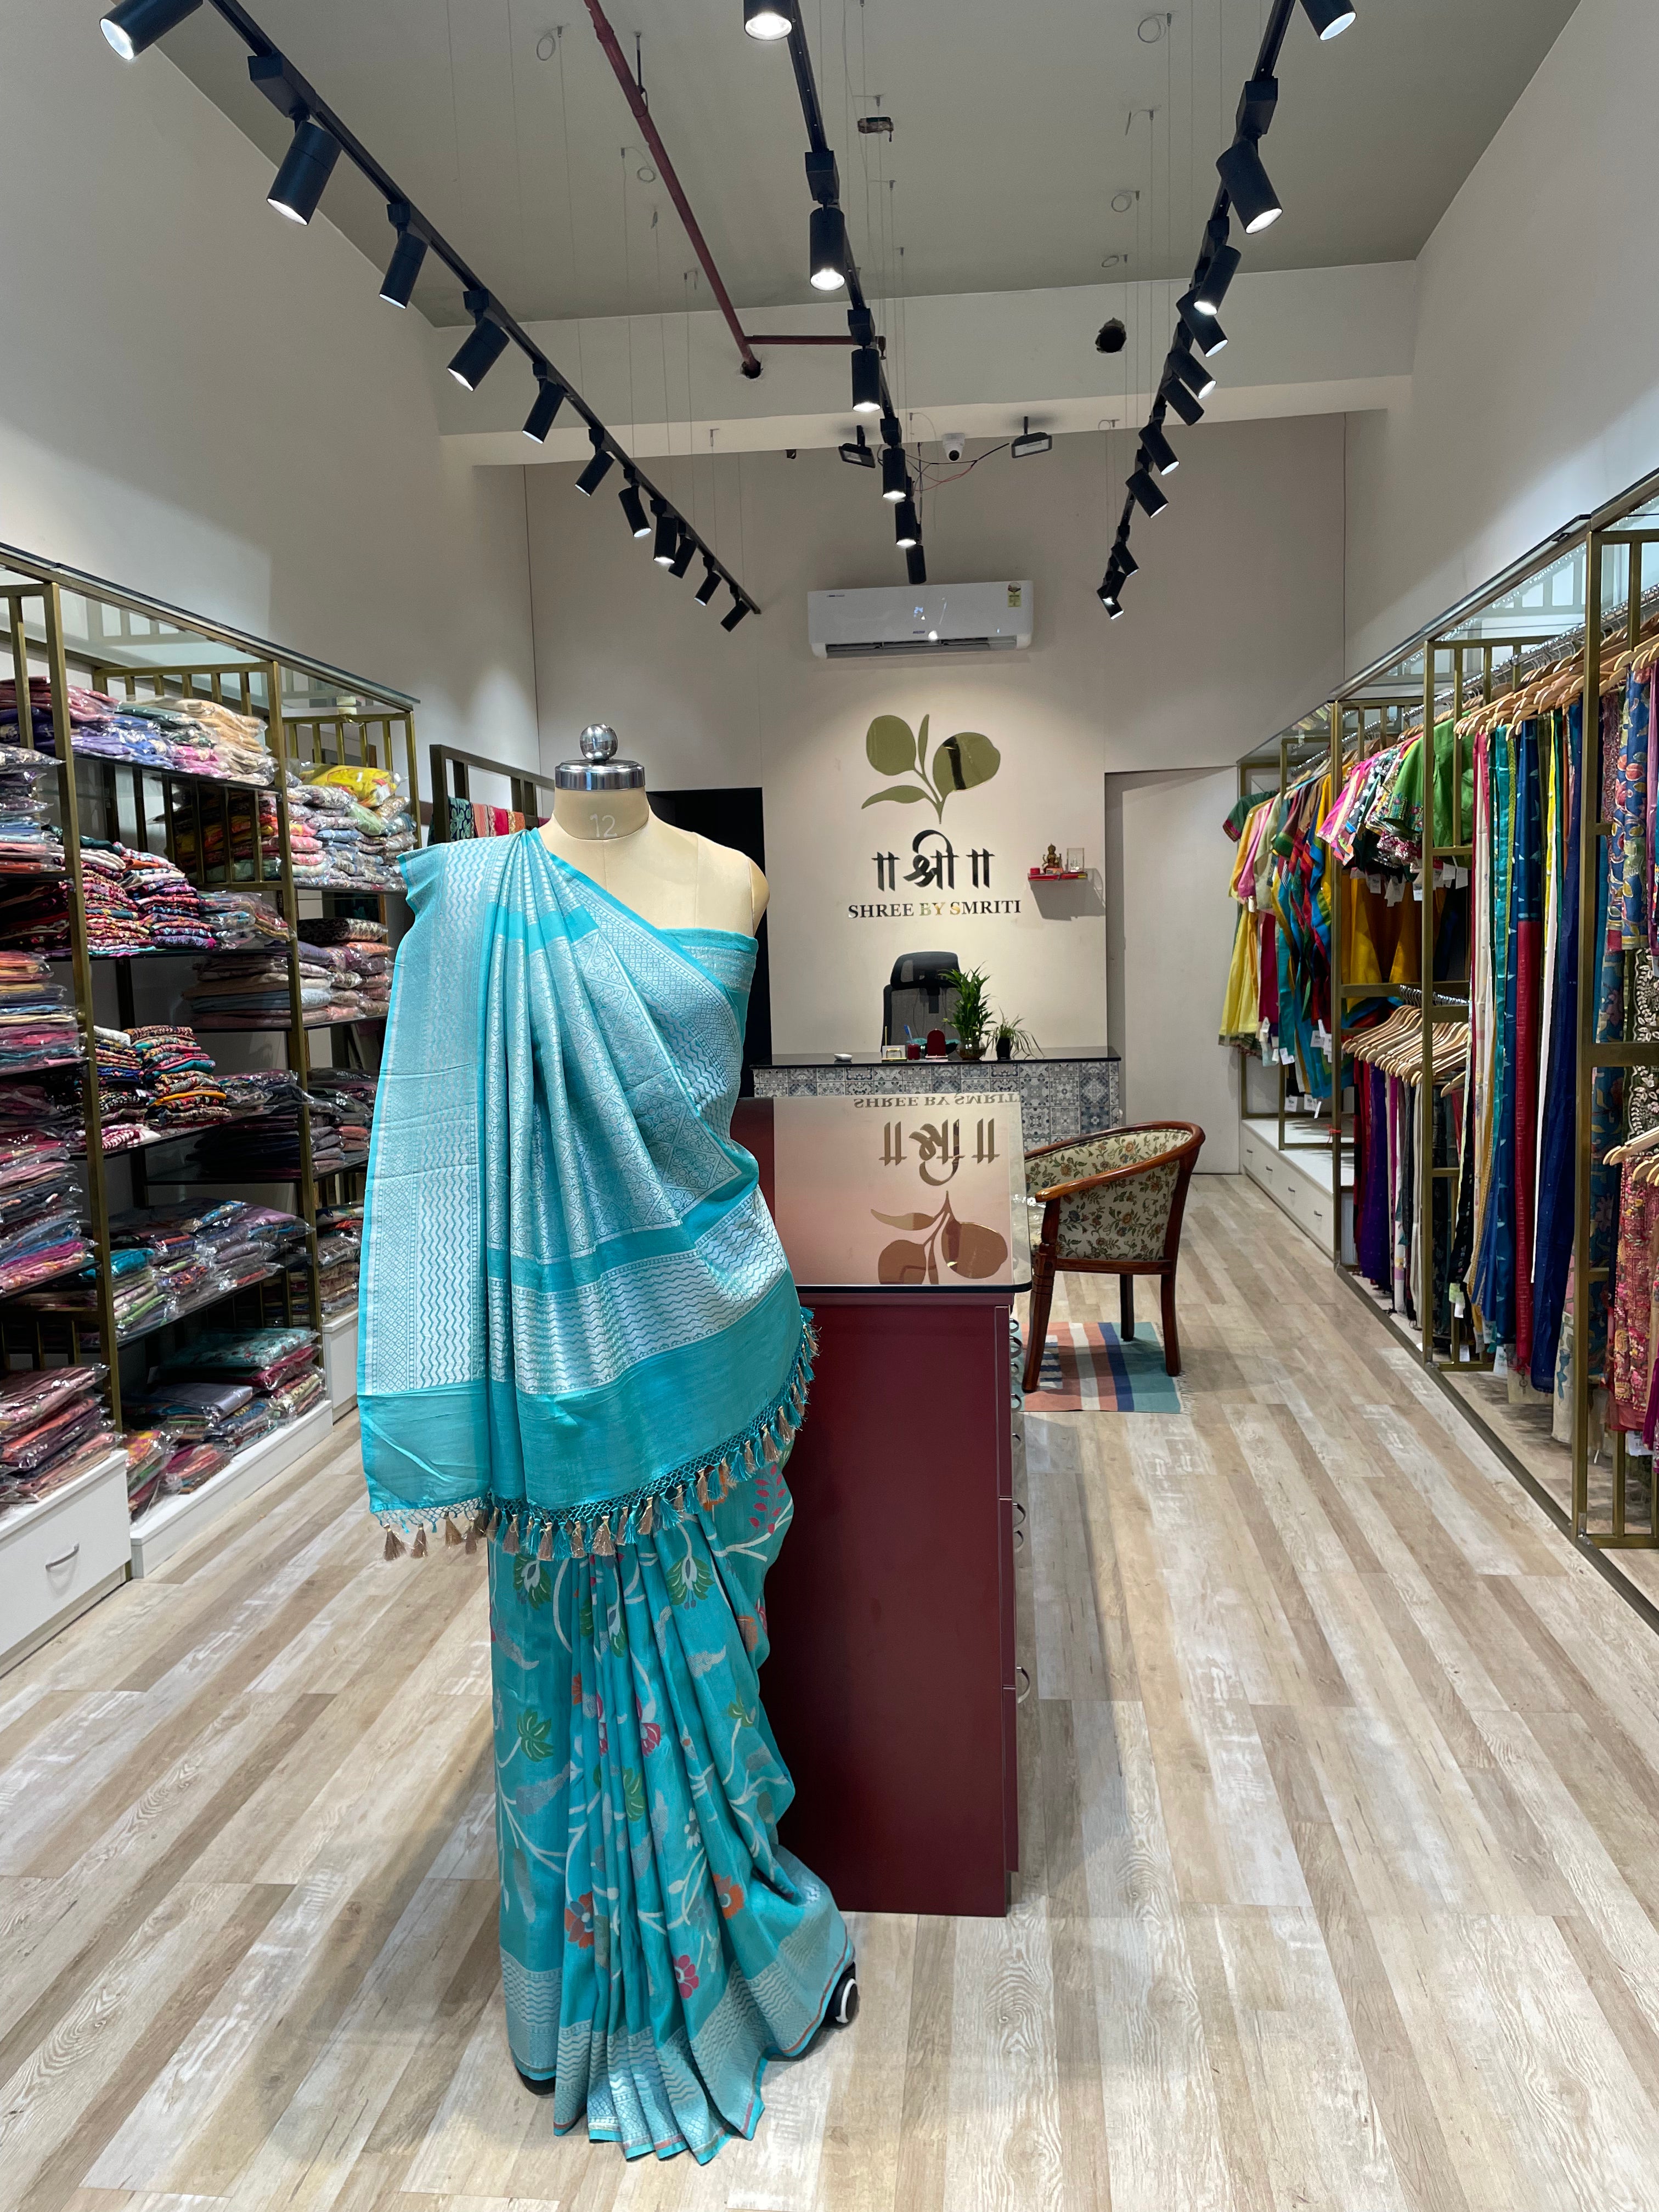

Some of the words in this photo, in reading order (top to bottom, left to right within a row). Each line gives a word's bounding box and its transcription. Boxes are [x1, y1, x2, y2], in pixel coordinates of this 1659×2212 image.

[589, 813, 618, 838] 12
[902, 829, 960, 890] श्री
[848, 903, 915, 919] SHREE
[919, 901, 946, 916] BY
[950, 900, 1022, 916] SMRITI
